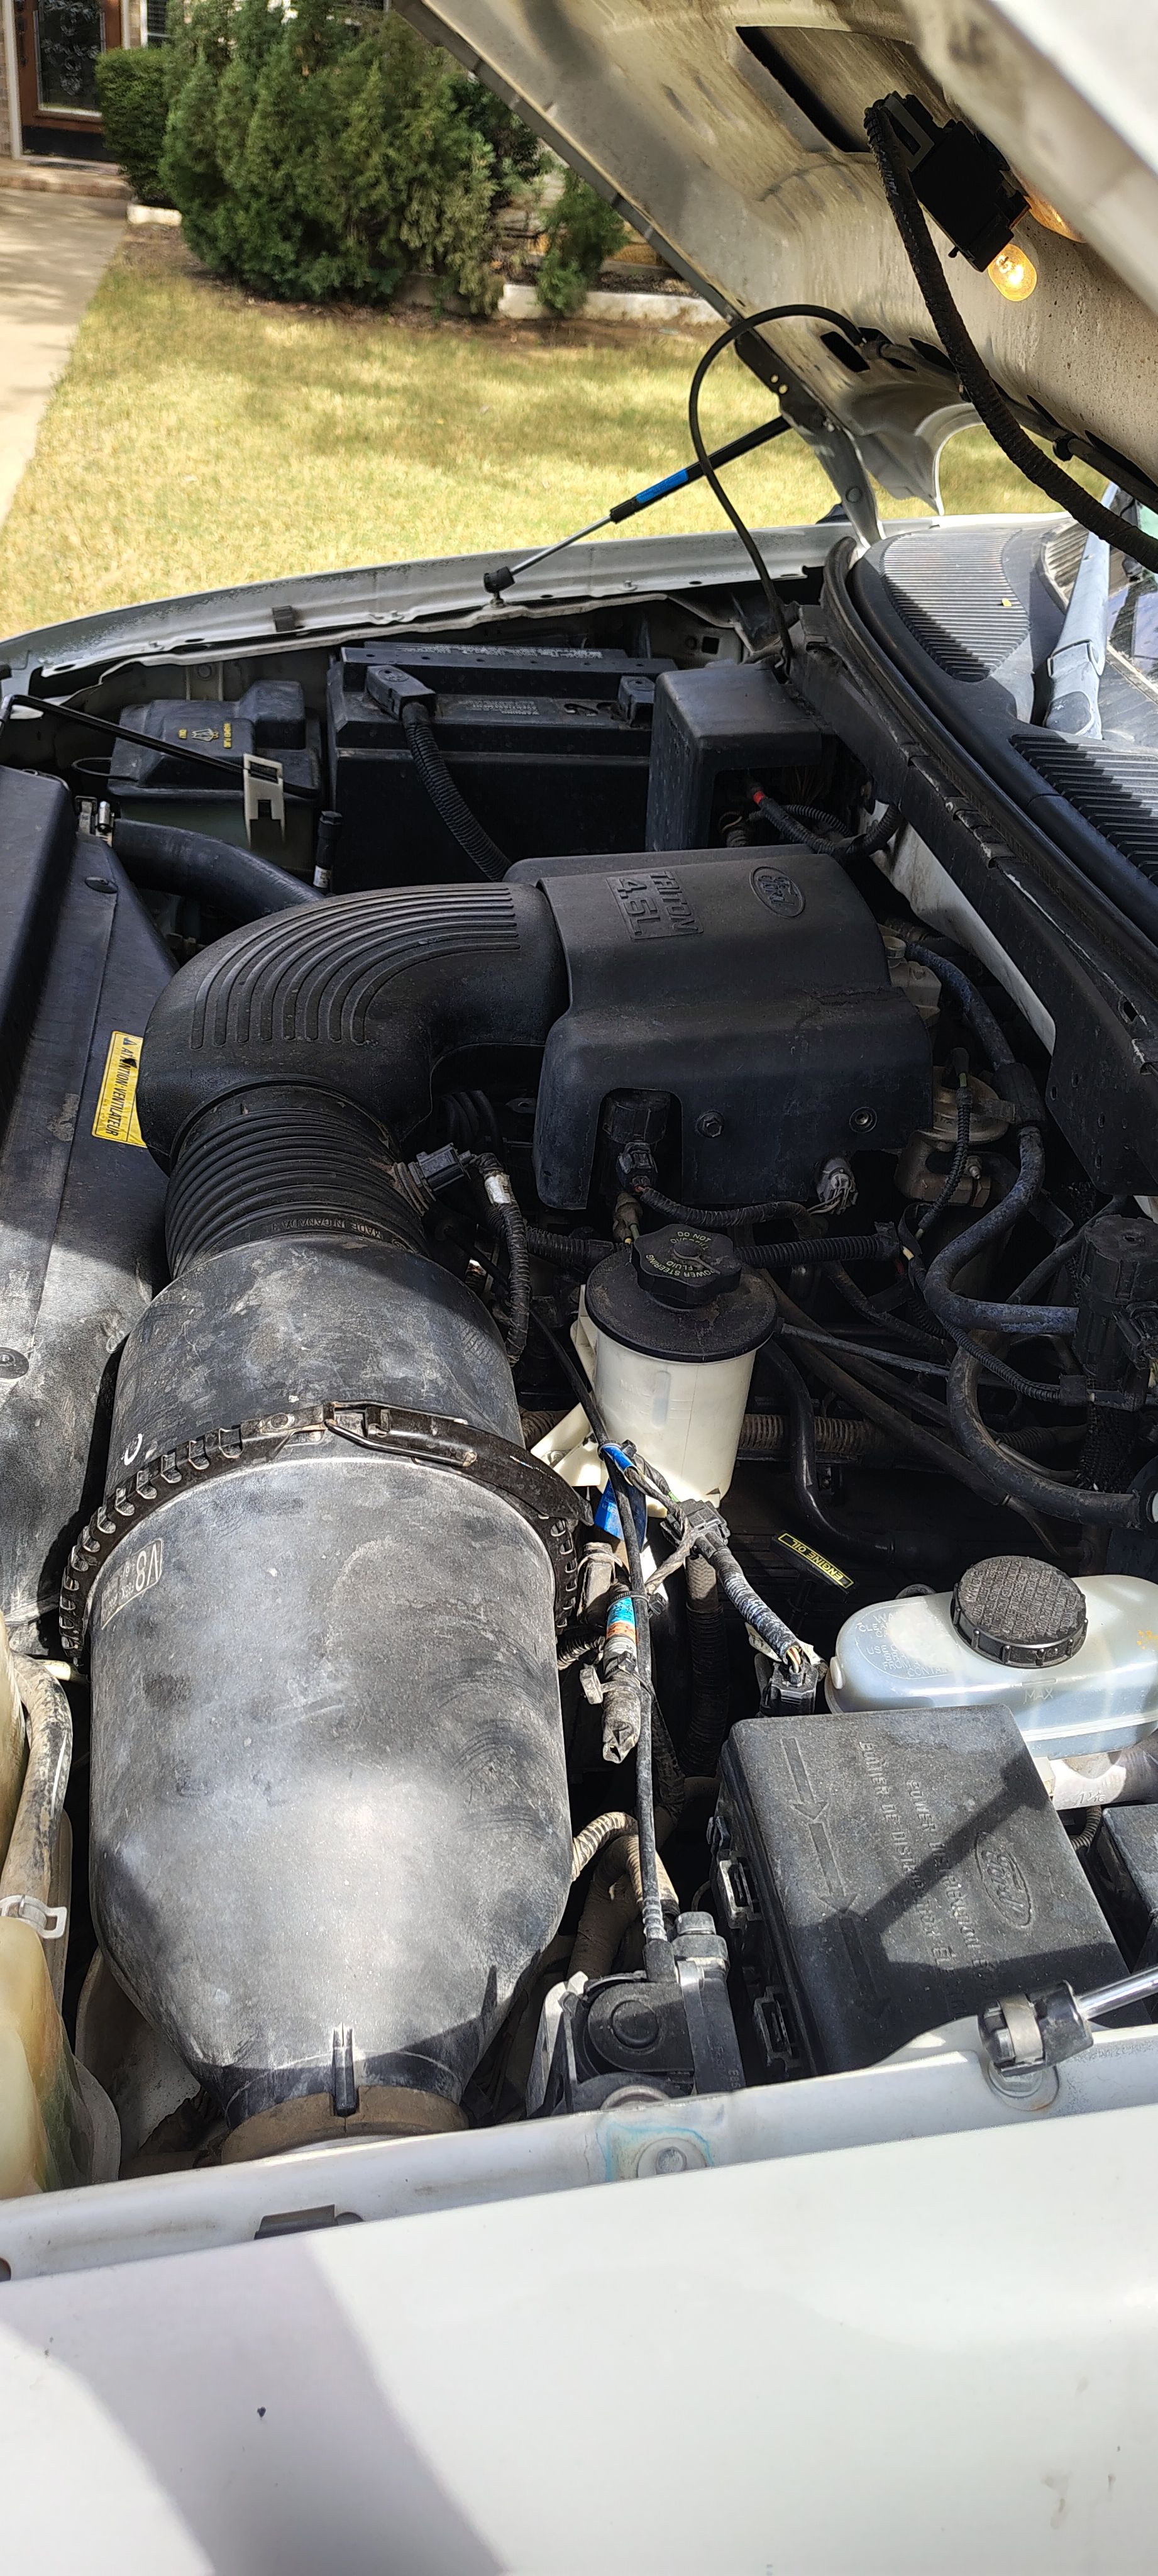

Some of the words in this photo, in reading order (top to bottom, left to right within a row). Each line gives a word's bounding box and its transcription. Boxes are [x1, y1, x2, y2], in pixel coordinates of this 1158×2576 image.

[650, 870, 699, 932] TRITON
[283, 1218, 331, 1230] CANADA
[334, 1218, 346, 1229] IN
[351, 1222, 382, 1240] MADE
[692, 1233, 712, 1243] NOT
[646, 1254, 681, 1277] STEERING
[666, 1260, 693, 1270] FLUID
[791, 1539, 807, 1553] OIL
[135, 1543, 159, 1592] V8
[806, 1551, 844, 1580] ENGINE
[866, 1644, 889, 1655] USE
[883, 1660, 912, 1671] FROM
[1024, 1687, 1054, 1704] MAX
[881, 1802, 900, 1823] DE
[907, 1779, 935, 1833] POWER
